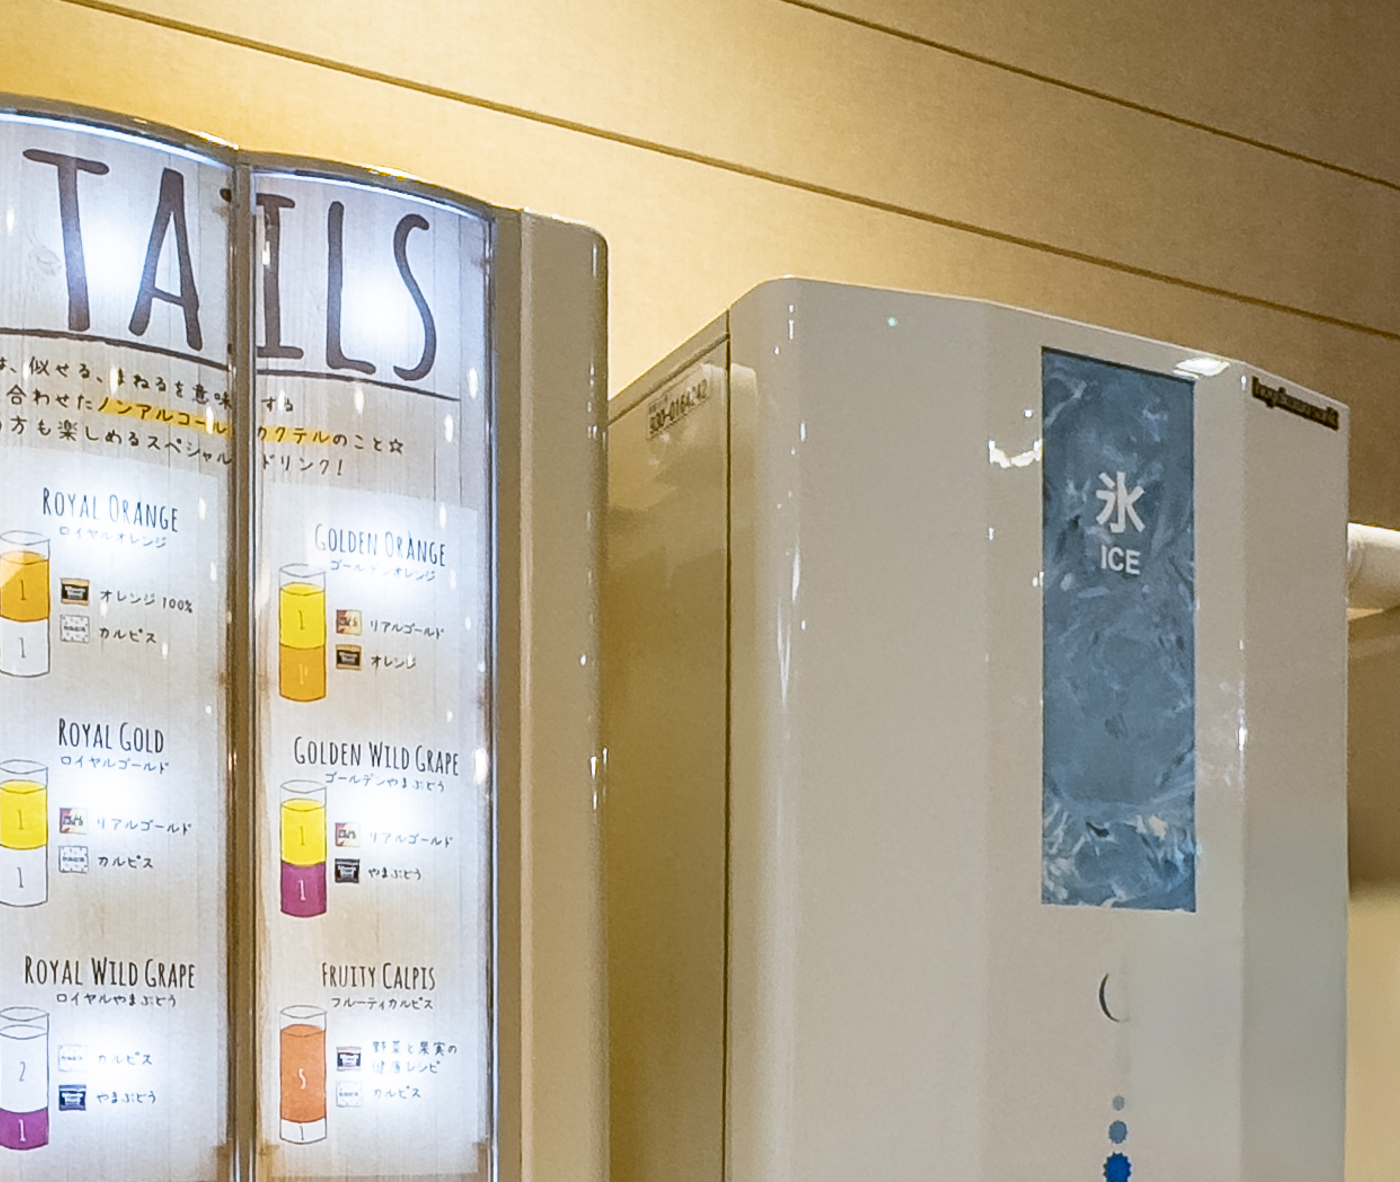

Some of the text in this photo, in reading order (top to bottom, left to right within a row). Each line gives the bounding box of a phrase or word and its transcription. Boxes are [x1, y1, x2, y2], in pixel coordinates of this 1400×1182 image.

[43, 487, 178, 533] ROYAL ORANGE
[1095, 471, 1146, 533] 氷
[1100, 545, 1141, 575] ICE
[58, 718, 164, 754] ROYAL GOLD
[294, 736, 459, 776] GOLDEN WILD GRAPE
[24, 955, 196, 989] ROYAL WILD GRAPE
[322, 962, 436, 991] FRUITY CALPIS
